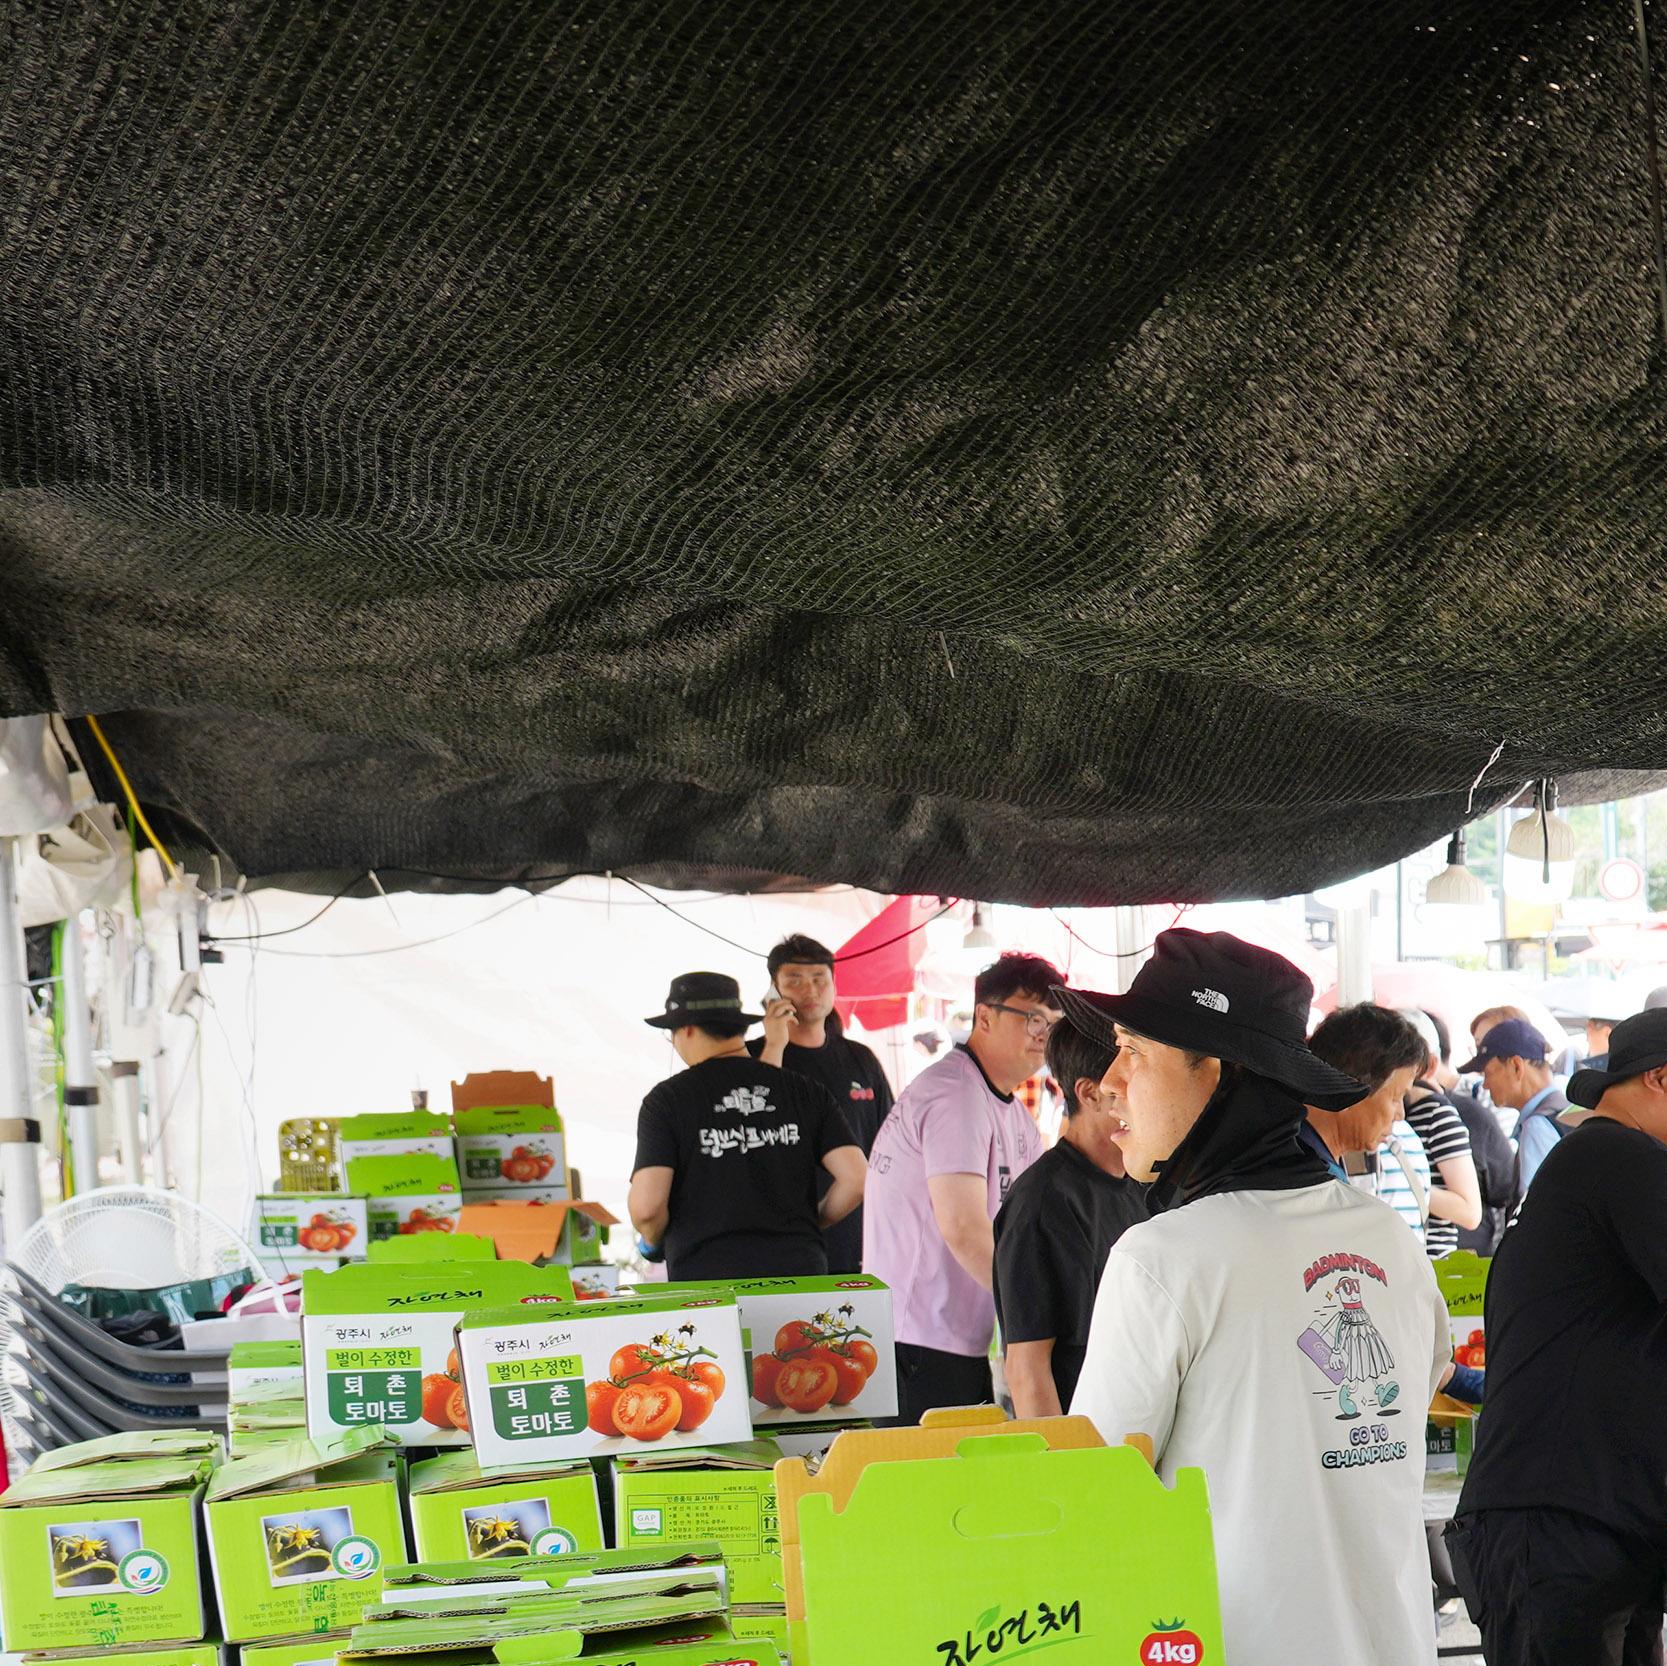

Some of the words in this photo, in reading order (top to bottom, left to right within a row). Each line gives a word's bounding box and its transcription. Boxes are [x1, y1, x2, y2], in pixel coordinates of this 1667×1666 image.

[1303, 1253, 1388, 1293] BADMINTON
[336, 1329, 371, 1340] 광주시
[495, 1339, 530, 1353] 광주시
[539, 1334, 572, 1350] 자연채
[336, 1352, 364, 1367] 벌이
[369, 1350, 412, 1366] 수정한
[497, 1363, 525, 1381] 벌이
[530, 1359, 573, 1377] 수정한
[346, 1401, 408, 1422] 토마토
[512, 1412, 575, 1435] 토마토
[1350, 1426, 1371, 1447] GO
[1371, 1423, 1389, 1442] TO
[1322, 1441, 1408, 1470] CHAMPIONS
[1148, 1637, 1197, 1664] 4kg
